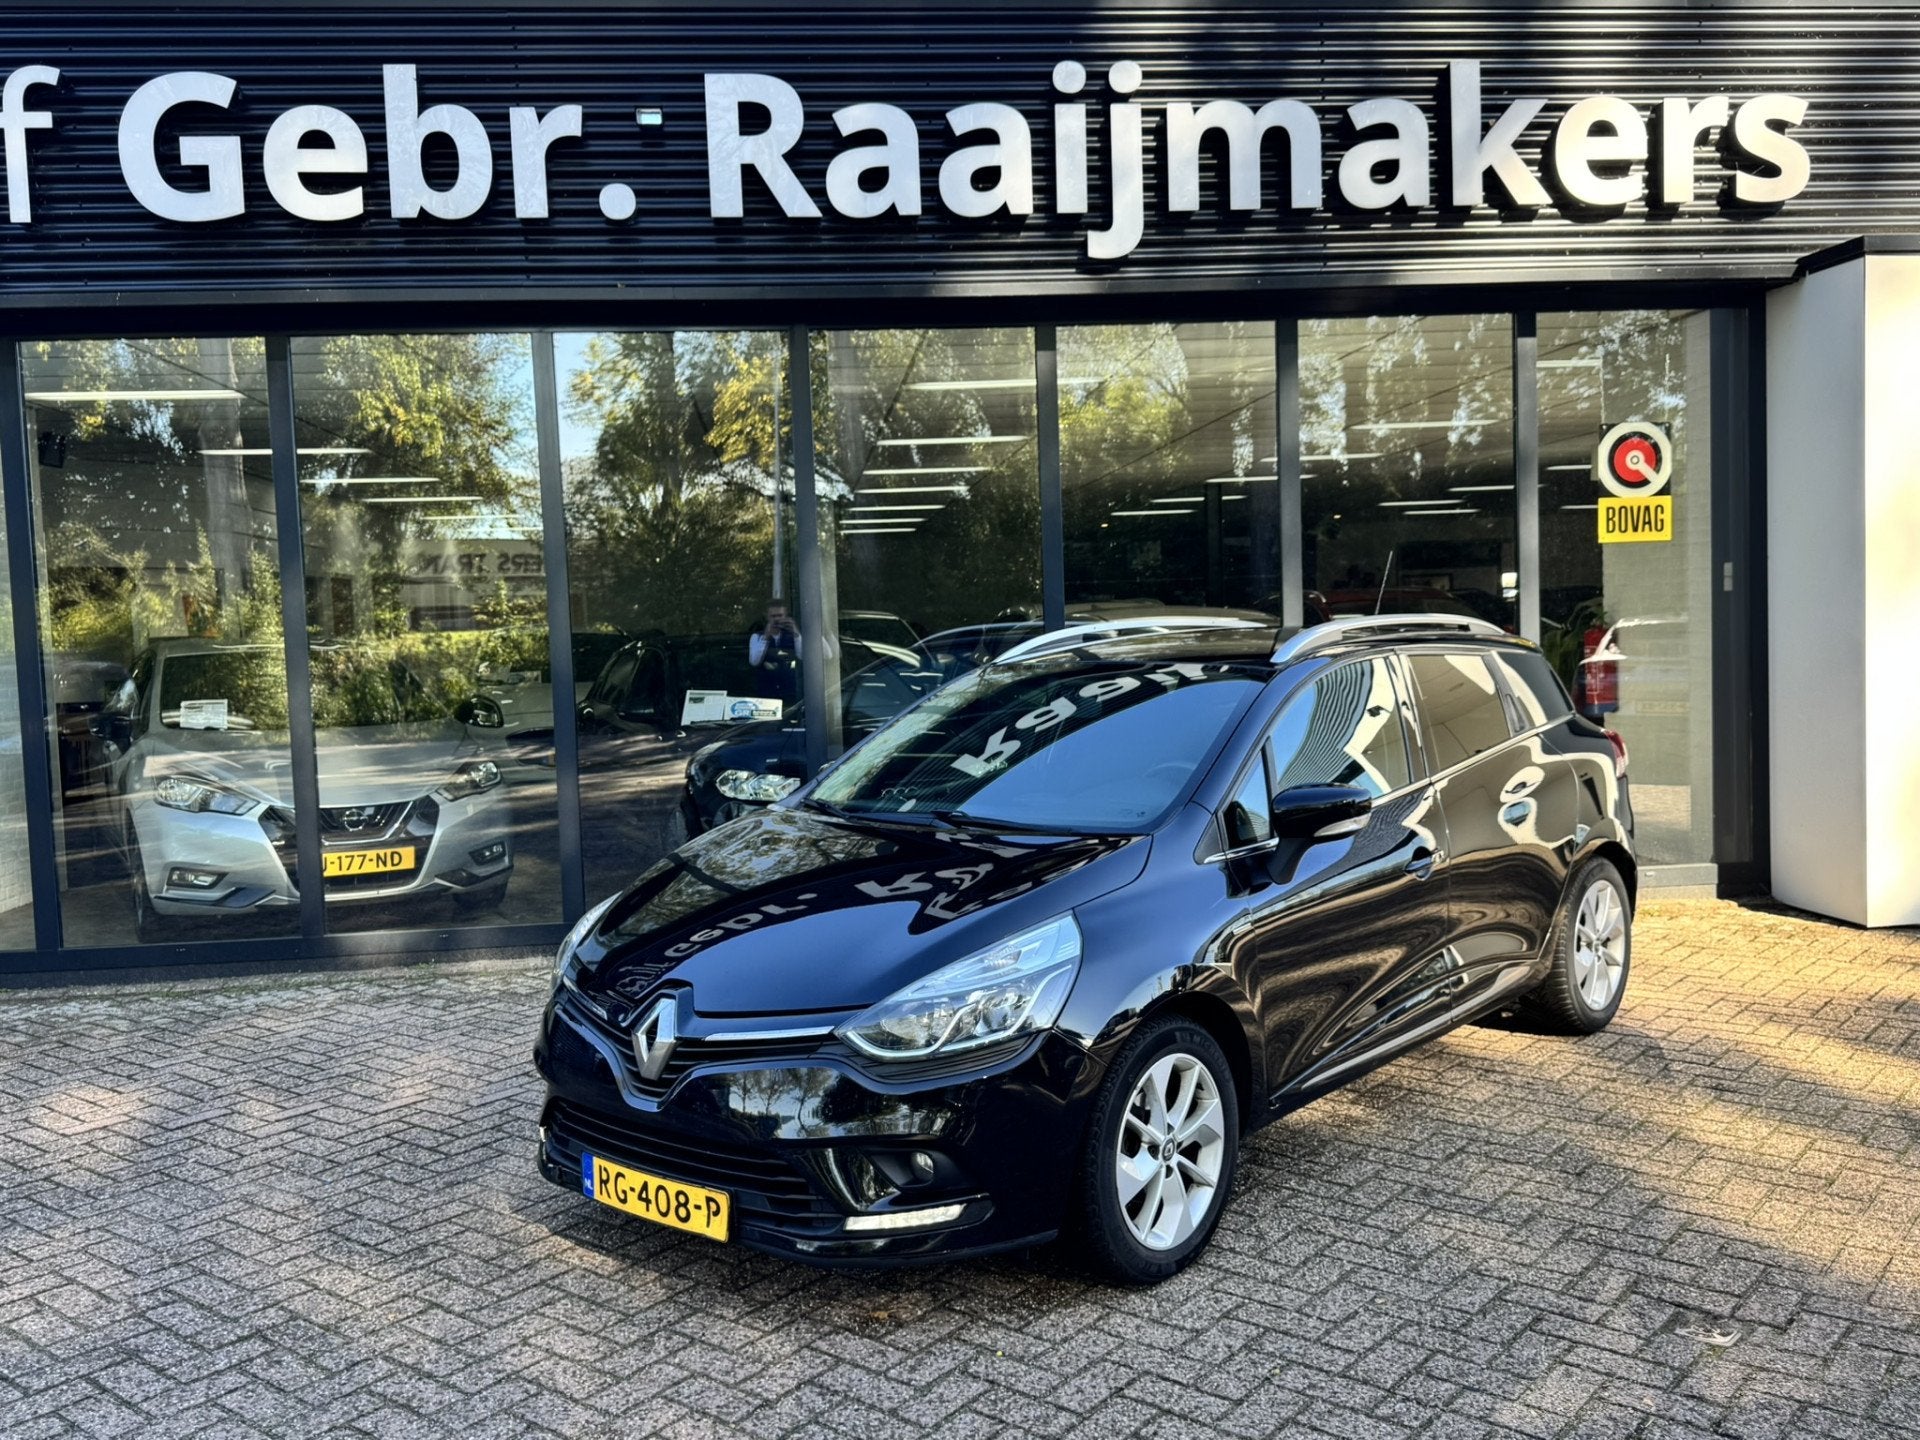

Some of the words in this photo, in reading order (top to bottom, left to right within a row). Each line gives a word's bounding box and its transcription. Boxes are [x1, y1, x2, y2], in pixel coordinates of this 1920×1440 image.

[118, 64, 637, 222] Gebr.
[704, 60, 1811, 259] Raaijmakers
[1606, 505, 1664, 533] BOVAG
[584, 1177, 594, 1190] NL
[599, 1164, 721, 1228] RG-408-P
